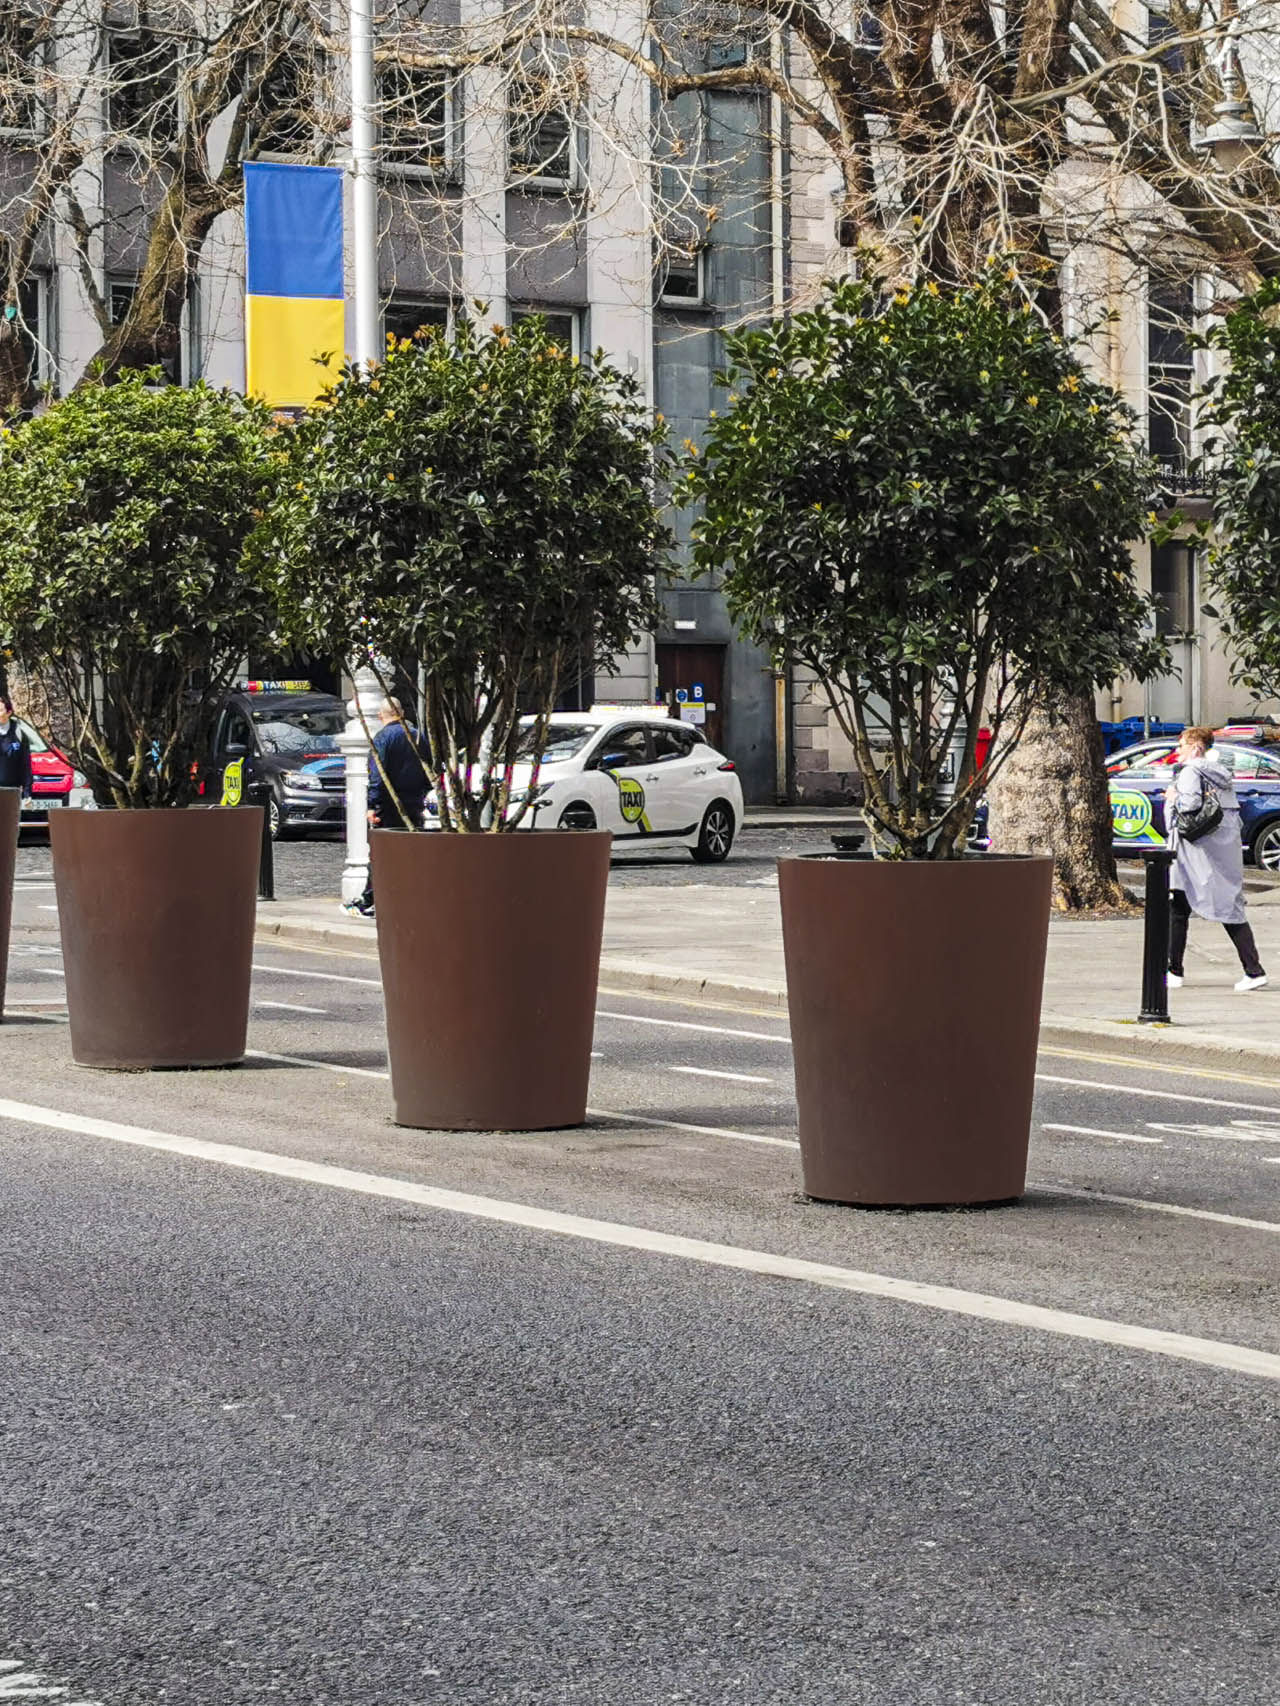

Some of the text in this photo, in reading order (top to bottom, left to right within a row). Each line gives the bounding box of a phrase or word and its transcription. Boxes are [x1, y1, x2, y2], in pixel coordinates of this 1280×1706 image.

[694, 686, 702, 698] B
[225, 775, 240, 790] TAXI
[620, 791, 644, 808] TAXI
[1111, 803, 1145, 820] TAXI
